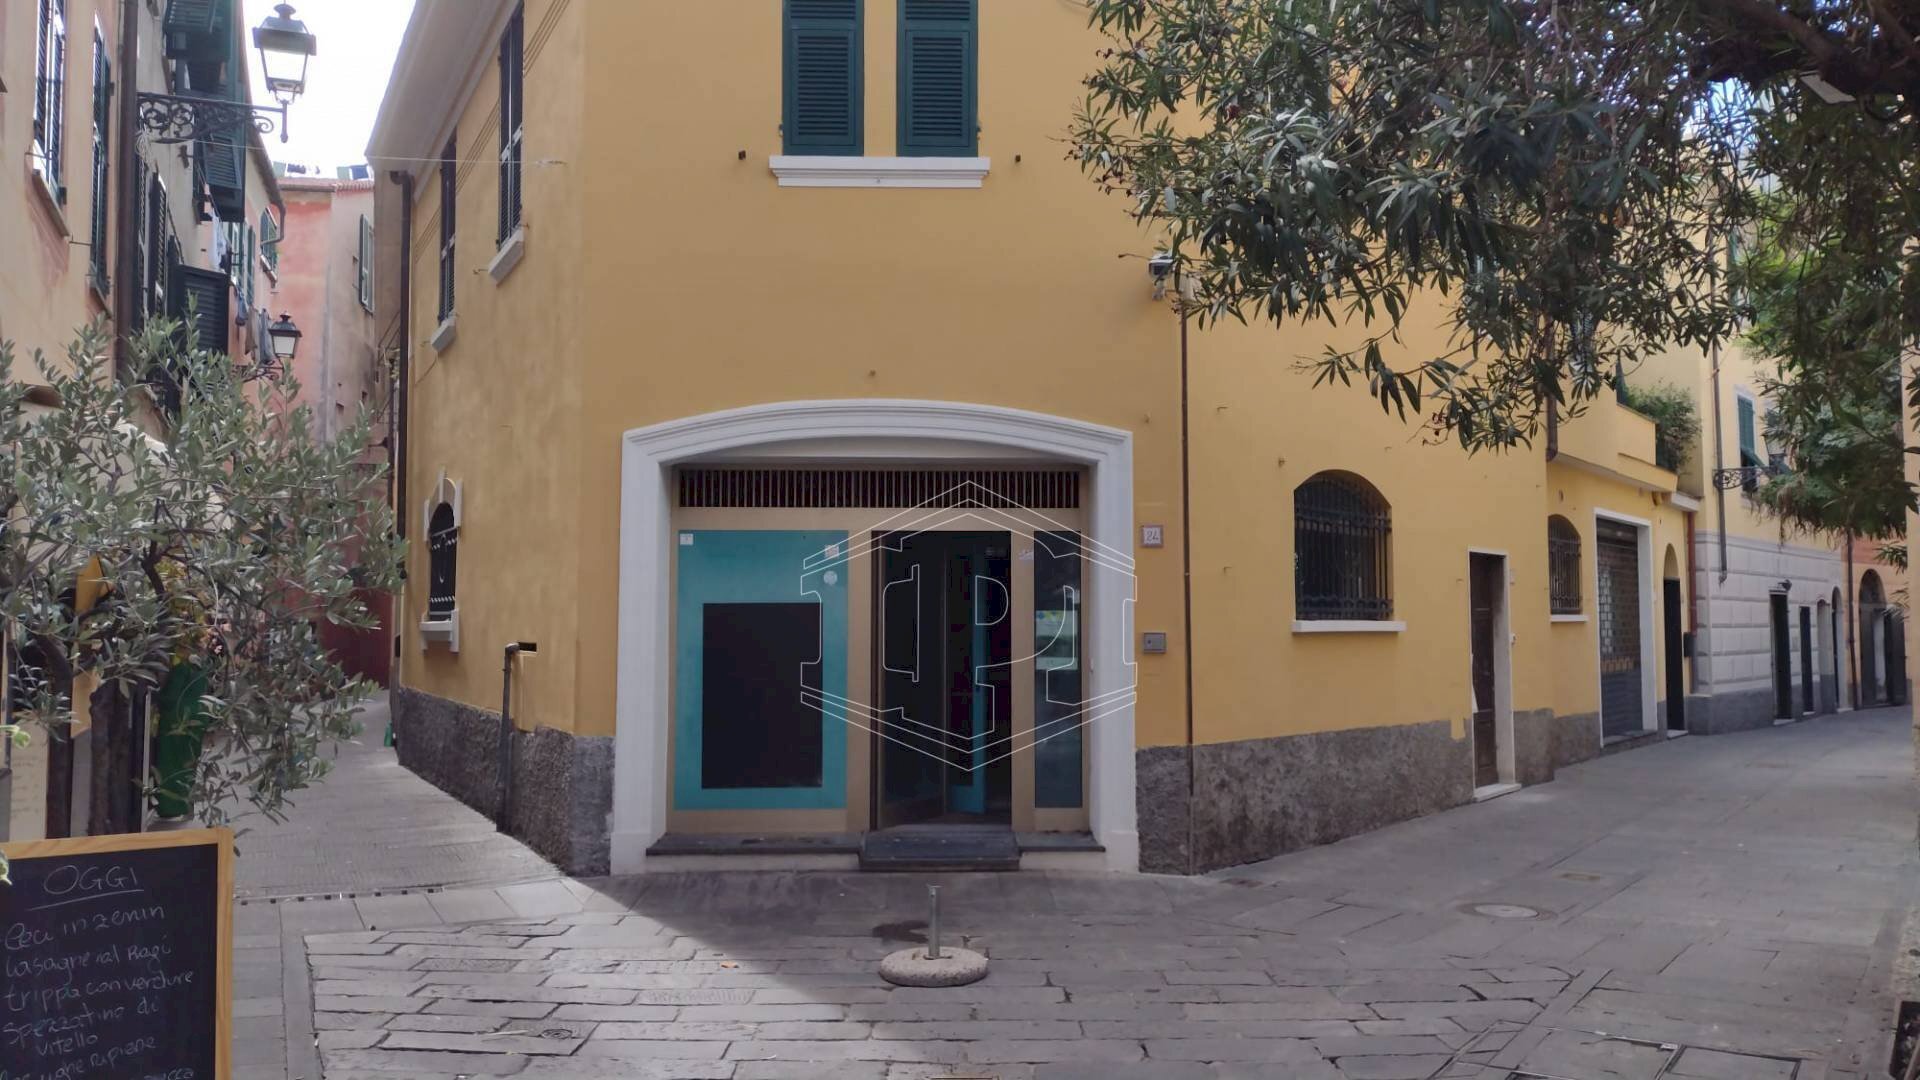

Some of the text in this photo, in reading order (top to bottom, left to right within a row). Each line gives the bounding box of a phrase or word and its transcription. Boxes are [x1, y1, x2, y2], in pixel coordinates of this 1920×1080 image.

[1146, 529, 1160, 541] 24
[43, 865, 139, 895] OGGI
[86, 980, 121, 995] con
[124, 969, 193, 991] verdure
[136, 995, 159, 1015] di
